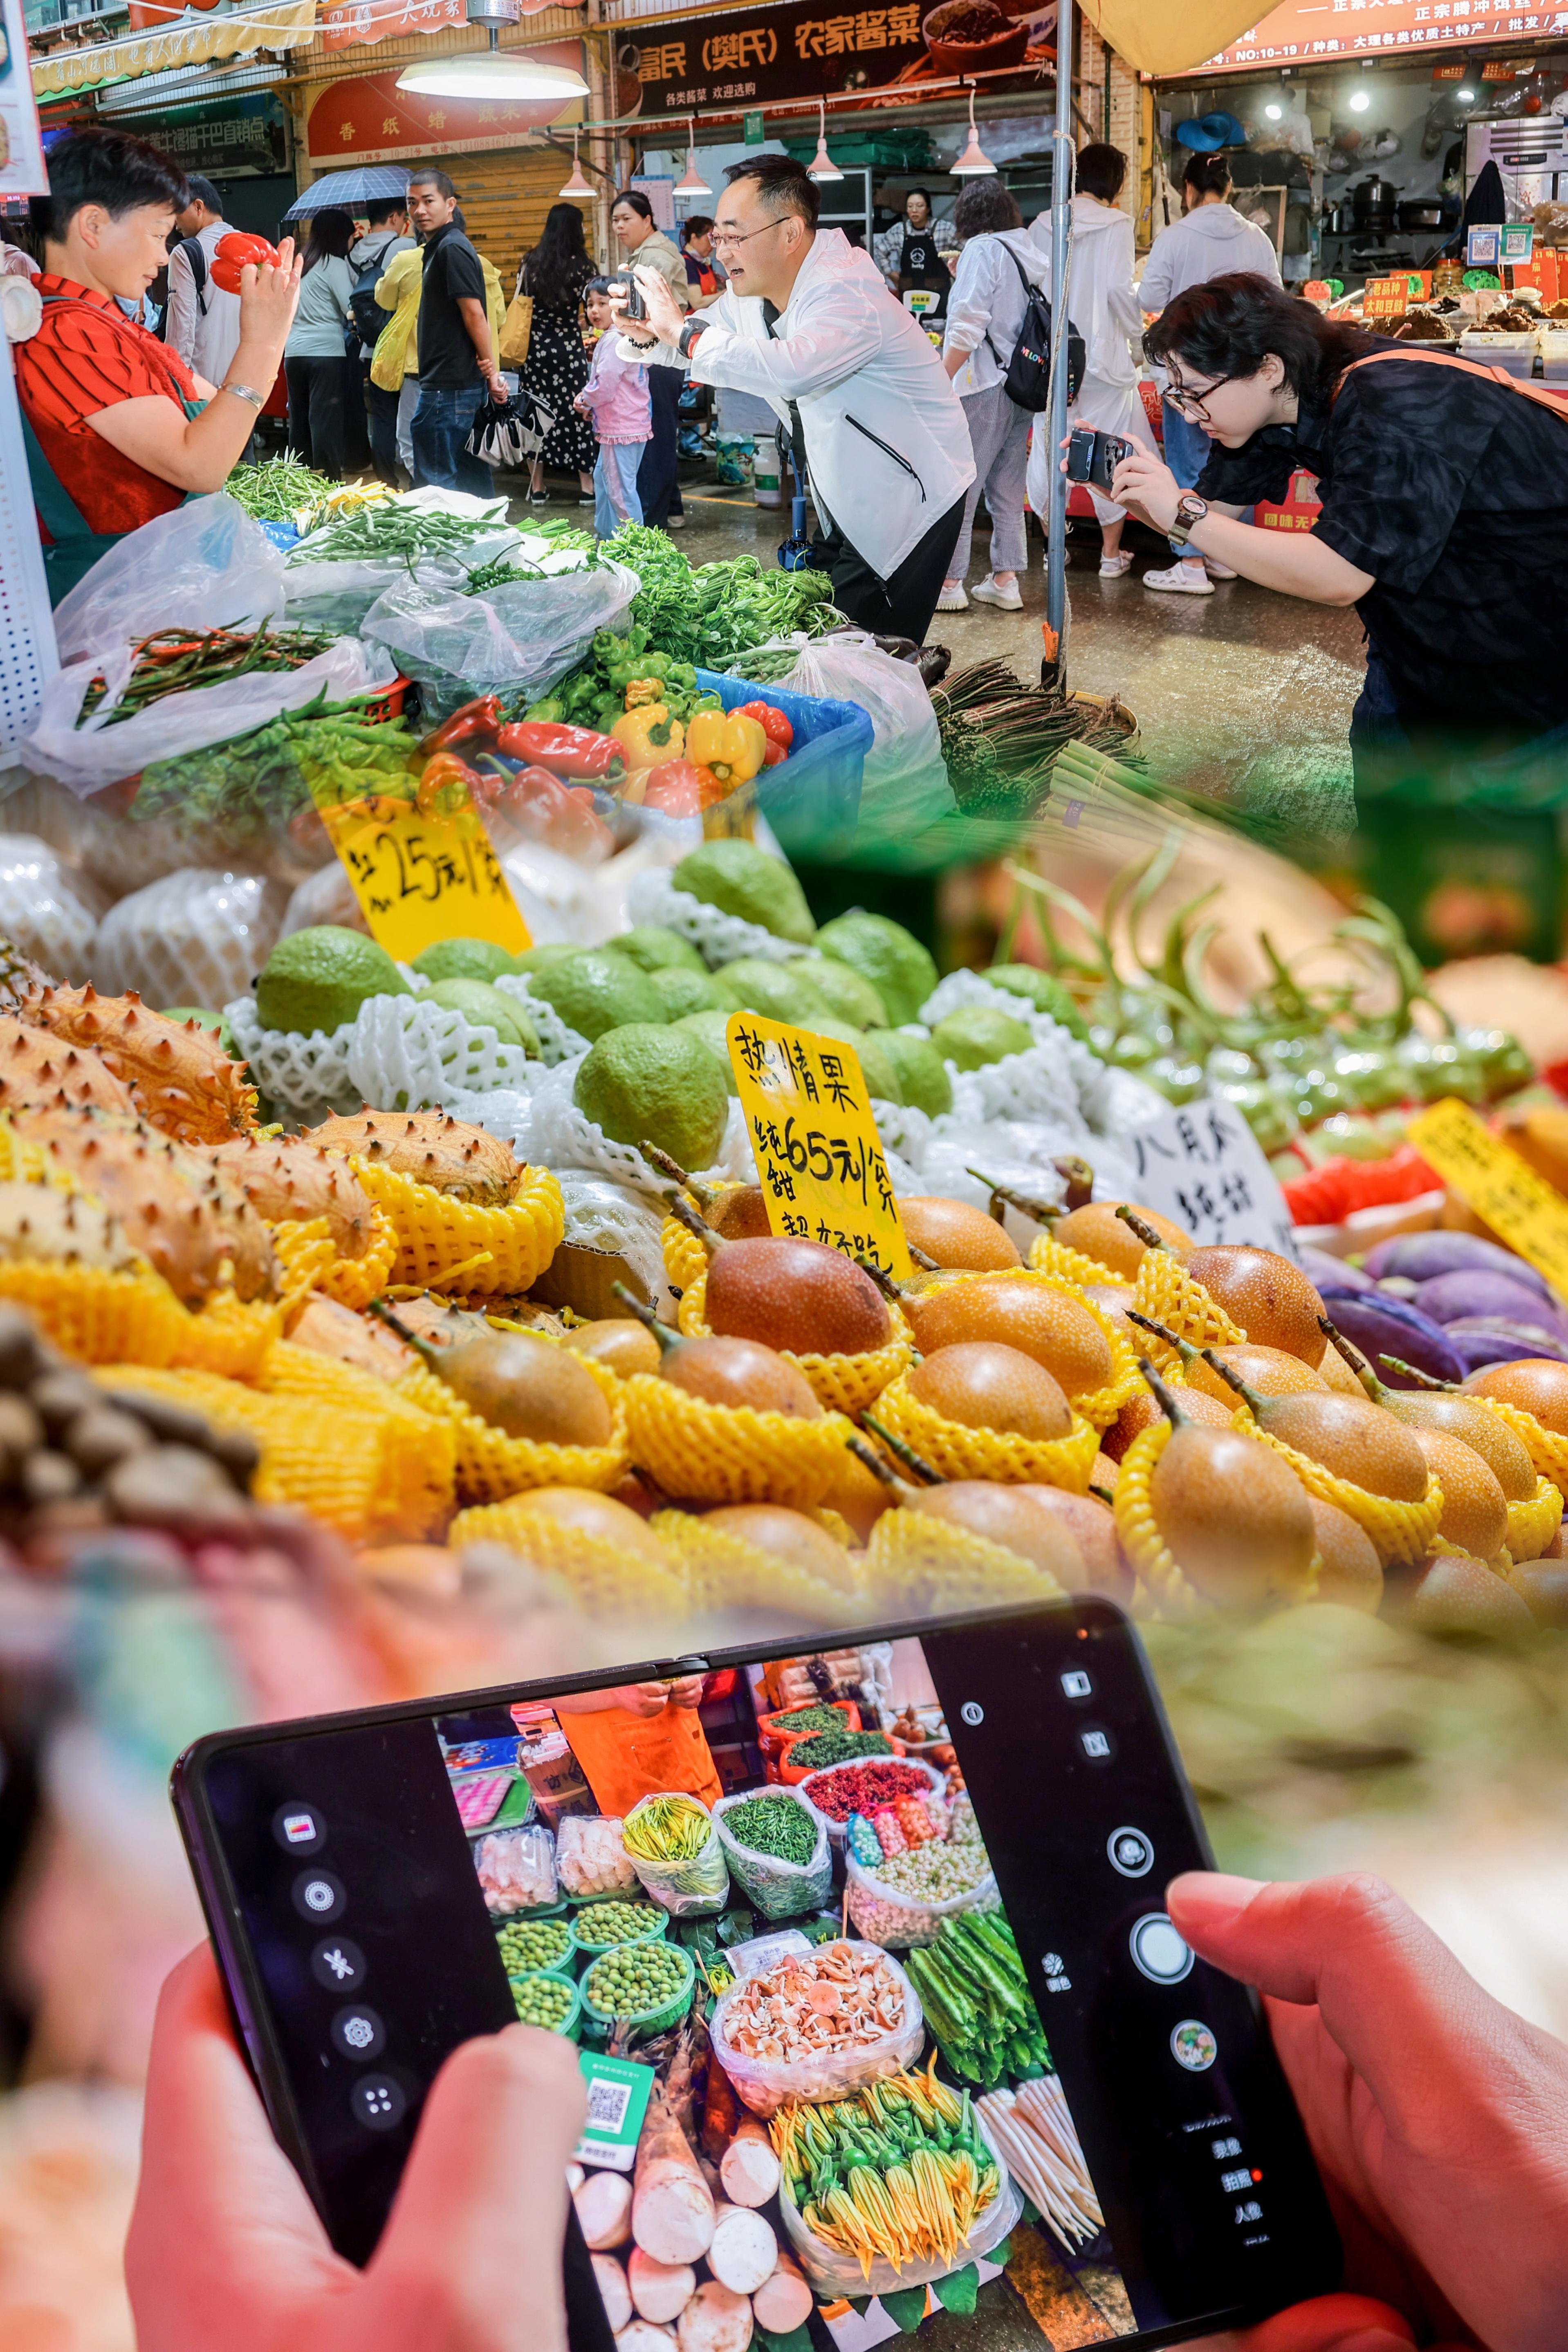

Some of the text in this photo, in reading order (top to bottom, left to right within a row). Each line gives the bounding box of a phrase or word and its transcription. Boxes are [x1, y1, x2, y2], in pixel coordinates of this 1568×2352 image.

[666, 82, 756, 107] 各类酱菜 欢迎选购
[1373, 281, 1400, 296] 老品种
[734, 1025, 859, 1113] 热情果
[1221, 2168, 1253, 2193] 拍照
[1235, 2201, 1264, 2224] 人像
